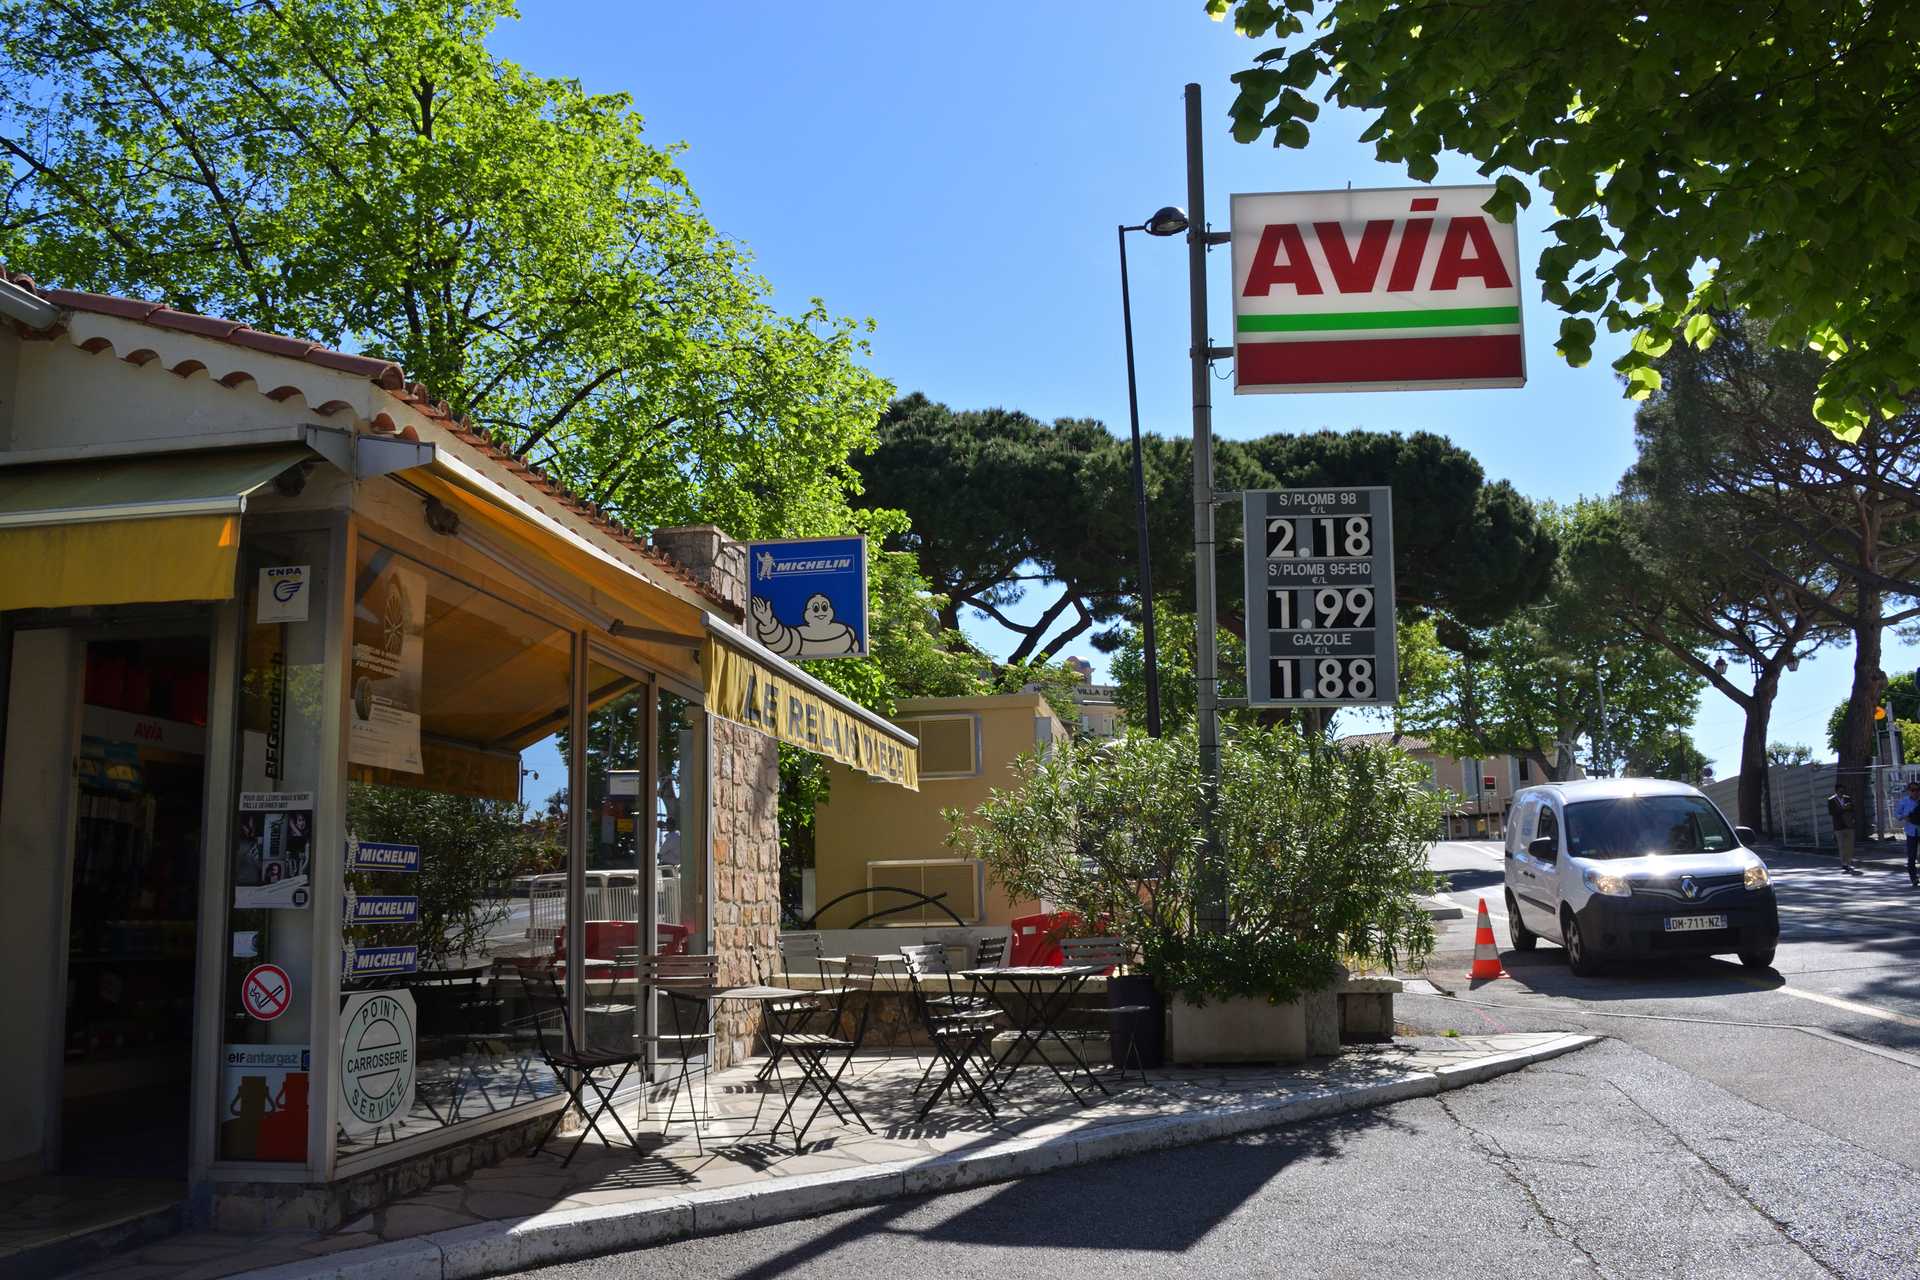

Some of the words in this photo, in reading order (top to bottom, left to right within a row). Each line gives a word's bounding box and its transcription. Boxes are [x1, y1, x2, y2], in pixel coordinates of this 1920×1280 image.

[1279, 494, 1335, 506] S/PLOMB
[1340, 493, 1357, 505] 98
[1310, 506, 1326, 514] €/L
[1268, 517, 1370, 558] 2.18
[268, 568, 302, 576] CNPA
[776, 559, 850, 572] MICHELIN
[1268, 564, 1325, 576] S/PLOMB
[1329, 562, 1371, 575] 95-E10
[1275, 588, 1374, 629] 1.99
[1293, 634, 1351, 646] GAZOLE
[1278, 659, 1374, 699] 1.88
[743, 674, 779, 730] LE
[264, 651, 282, 780] BFGoodrich
[360, 848, 417, 864] MICHELIN
[358, 902, 416, 916] MICHELIN
[357, 952, 415, 969] MICHELIN
[362, 1000, 398, 1025] POINT
[347, 1049, 408, 1074] CARROSSERIE
[352, 1078, 404, 1119] SERVICE
